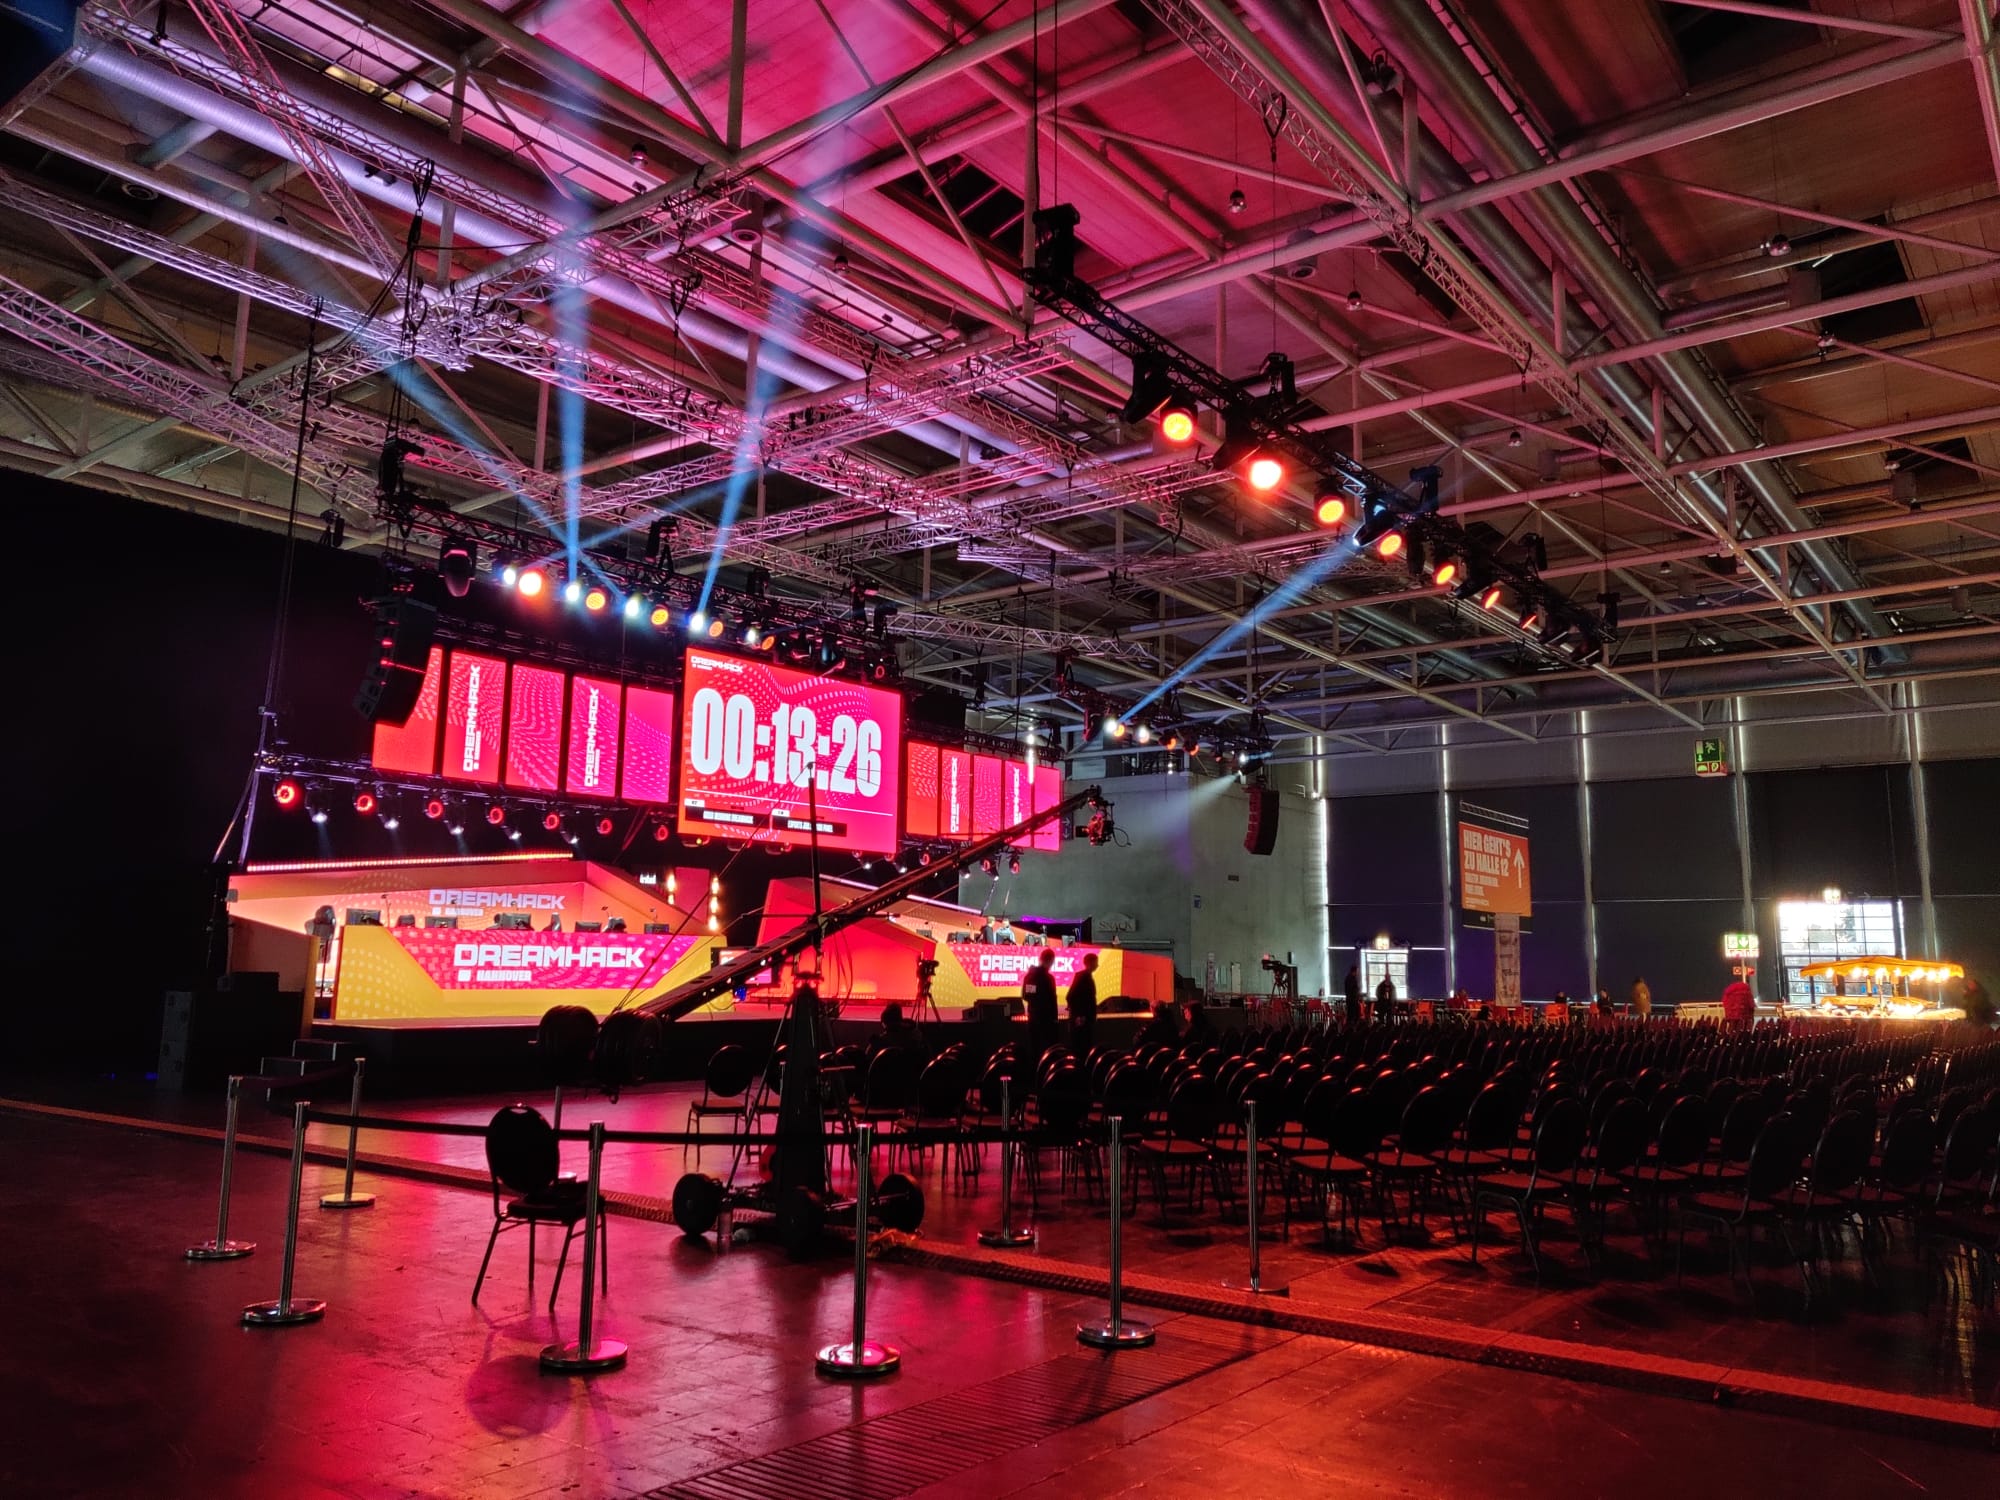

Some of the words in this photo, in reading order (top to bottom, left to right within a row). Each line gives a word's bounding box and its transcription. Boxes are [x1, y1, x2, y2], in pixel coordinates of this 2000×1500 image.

[463, 664, 480, 771] DREAMHACK
[584, 688, 599, 787] DREAMHACK
[691, 688, 882, 797] 00:13:26
[1463, 829, 1483, 852] HIER
[1463, 849, 1476, 870] ZU
[1476, 852, 1500, 876] HALLE
[428, 889, 566, 910] DREAMHACK
[453, 943, 645, 968] DREAMHACK
[979, 954, 1074, 972] DREAMCK
[476, 969, 533, 982] HANNOVER
